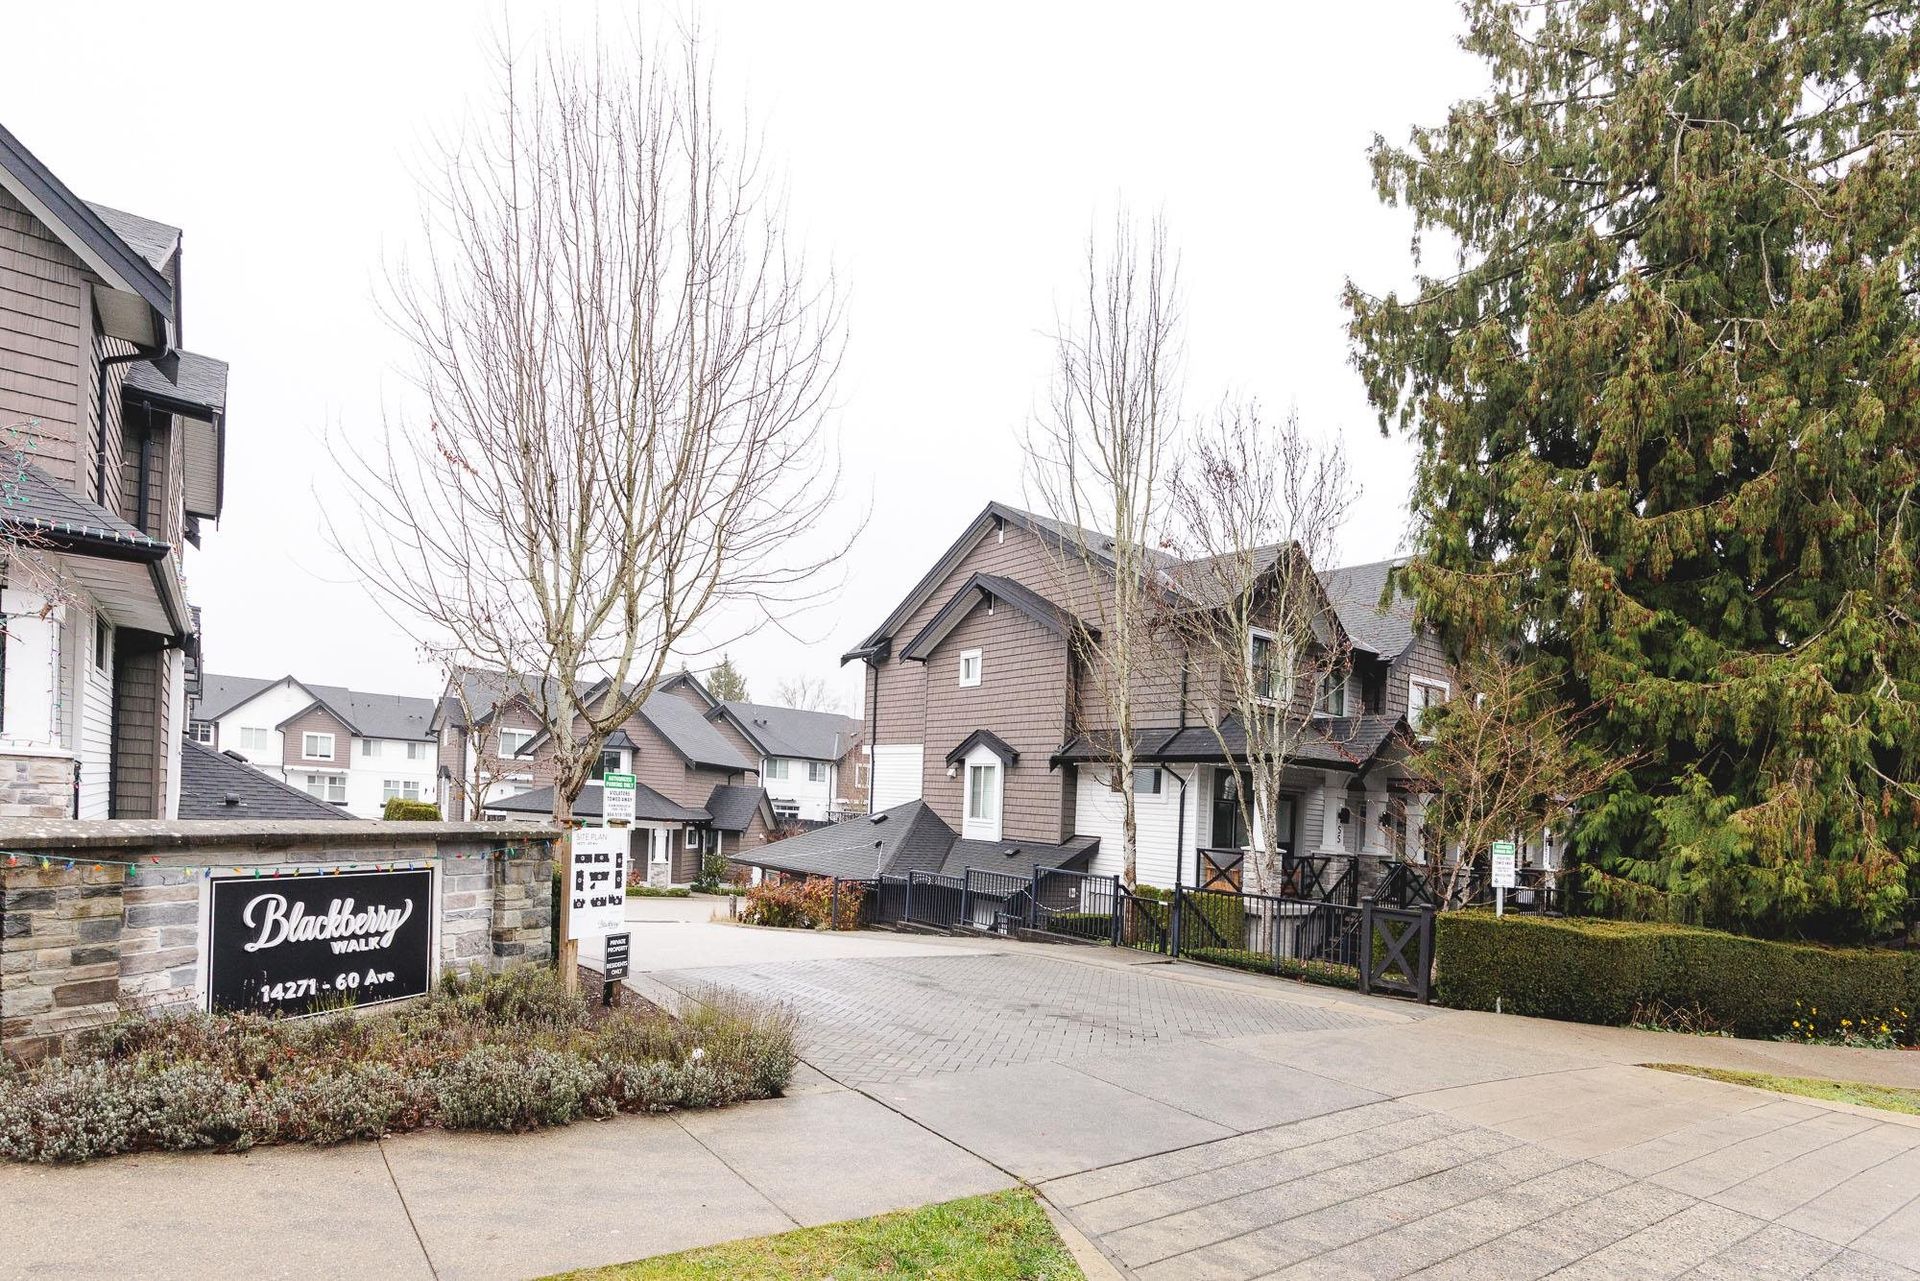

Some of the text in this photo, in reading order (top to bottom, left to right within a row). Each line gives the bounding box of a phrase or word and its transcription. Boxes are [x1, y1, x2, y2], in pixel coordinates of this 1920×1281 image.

[576, 832, 608, 840] SITE PLAN
[243, 893, 413, 953] Blackberry
[330, 936, 381, 955] WALK
[606, 961, 628, 969] RESIDENTS
[261, 978, 317, 1002] 14271
[335, 972, 360, 991] 60
[364, 968, 395, 986] Ave
